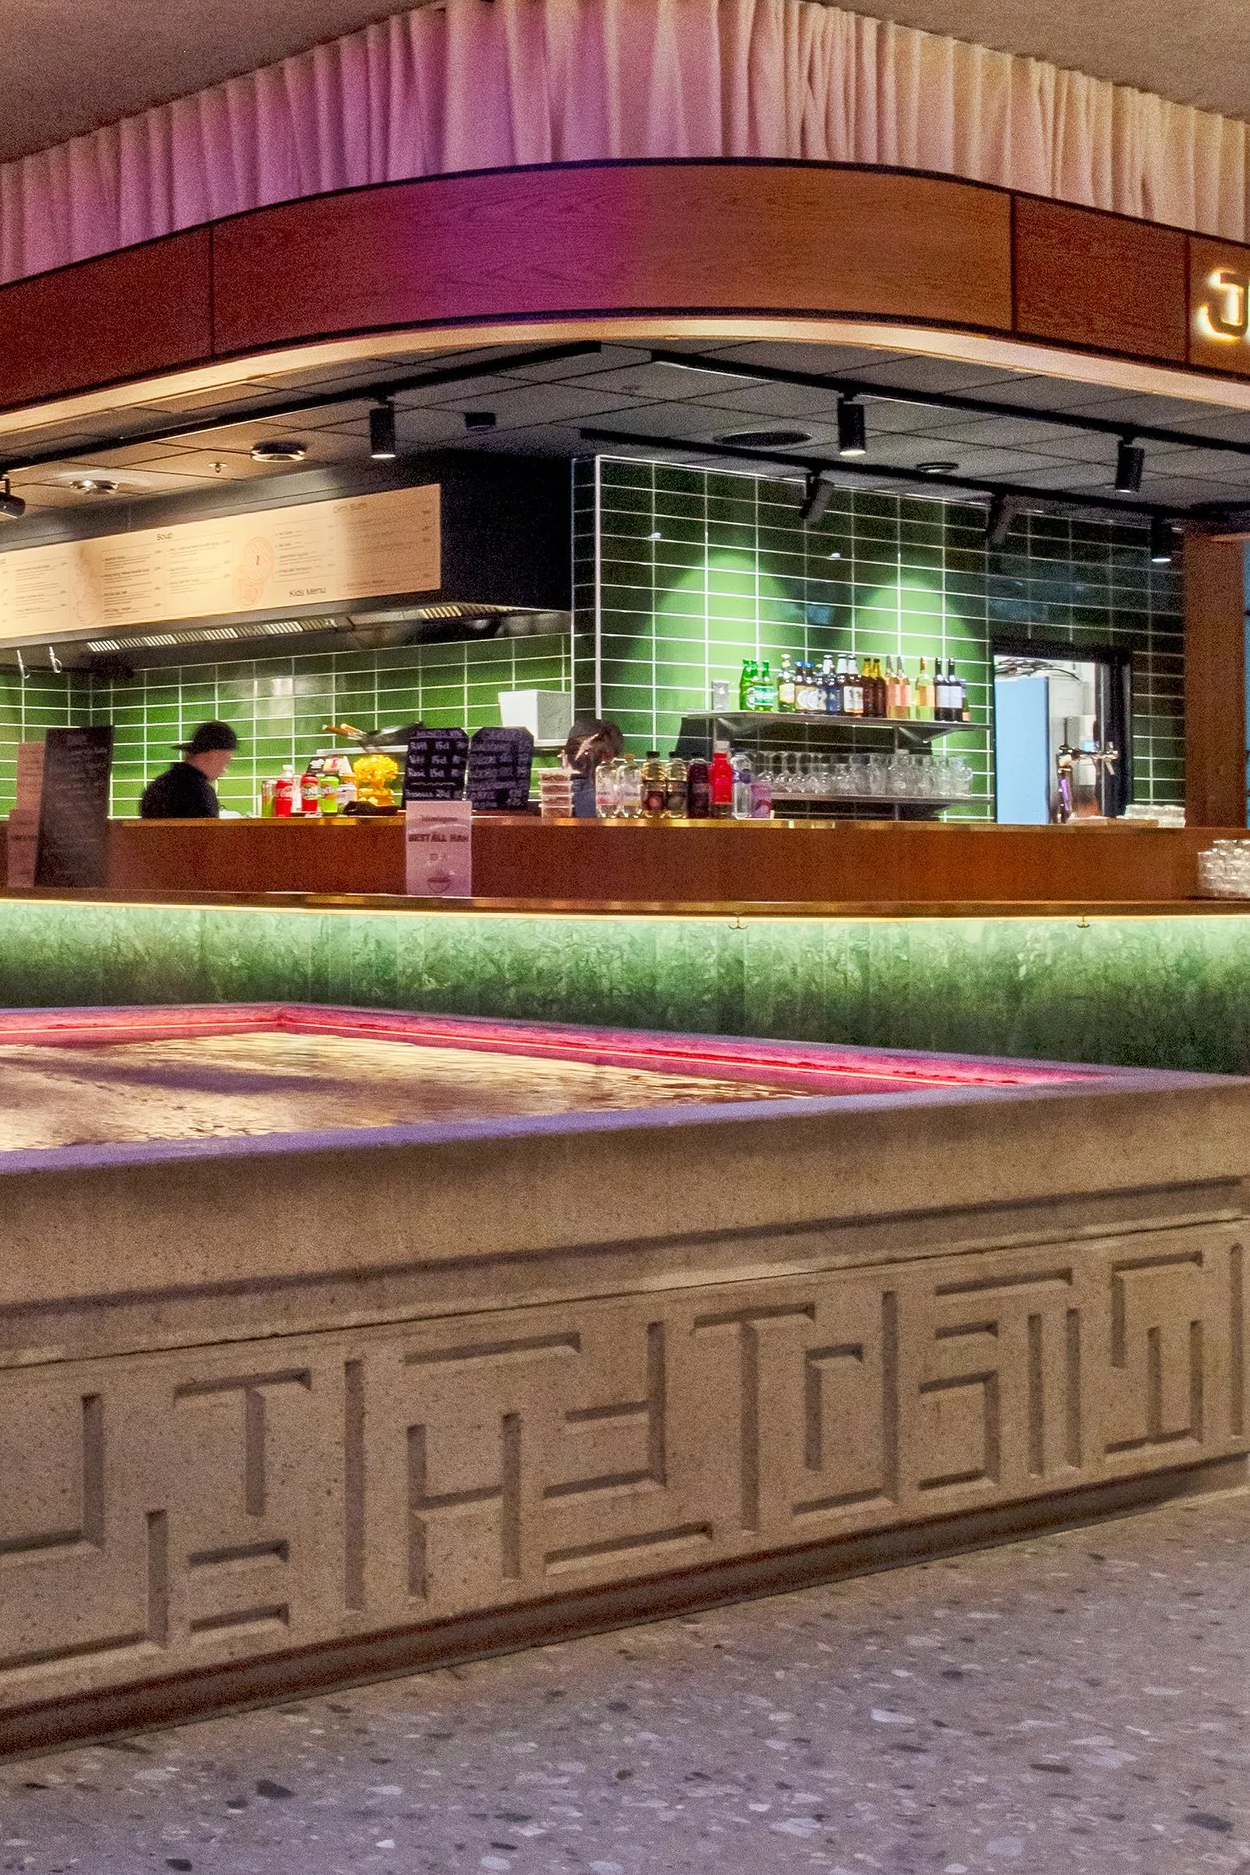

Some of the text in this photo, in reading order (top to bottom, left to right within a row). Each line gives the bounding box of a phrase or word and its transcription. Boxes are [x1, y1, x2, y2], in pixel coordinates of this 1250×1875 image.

[157, 533, 173, 541] Soup
[289, 587, 326, 598] Kids Menu
